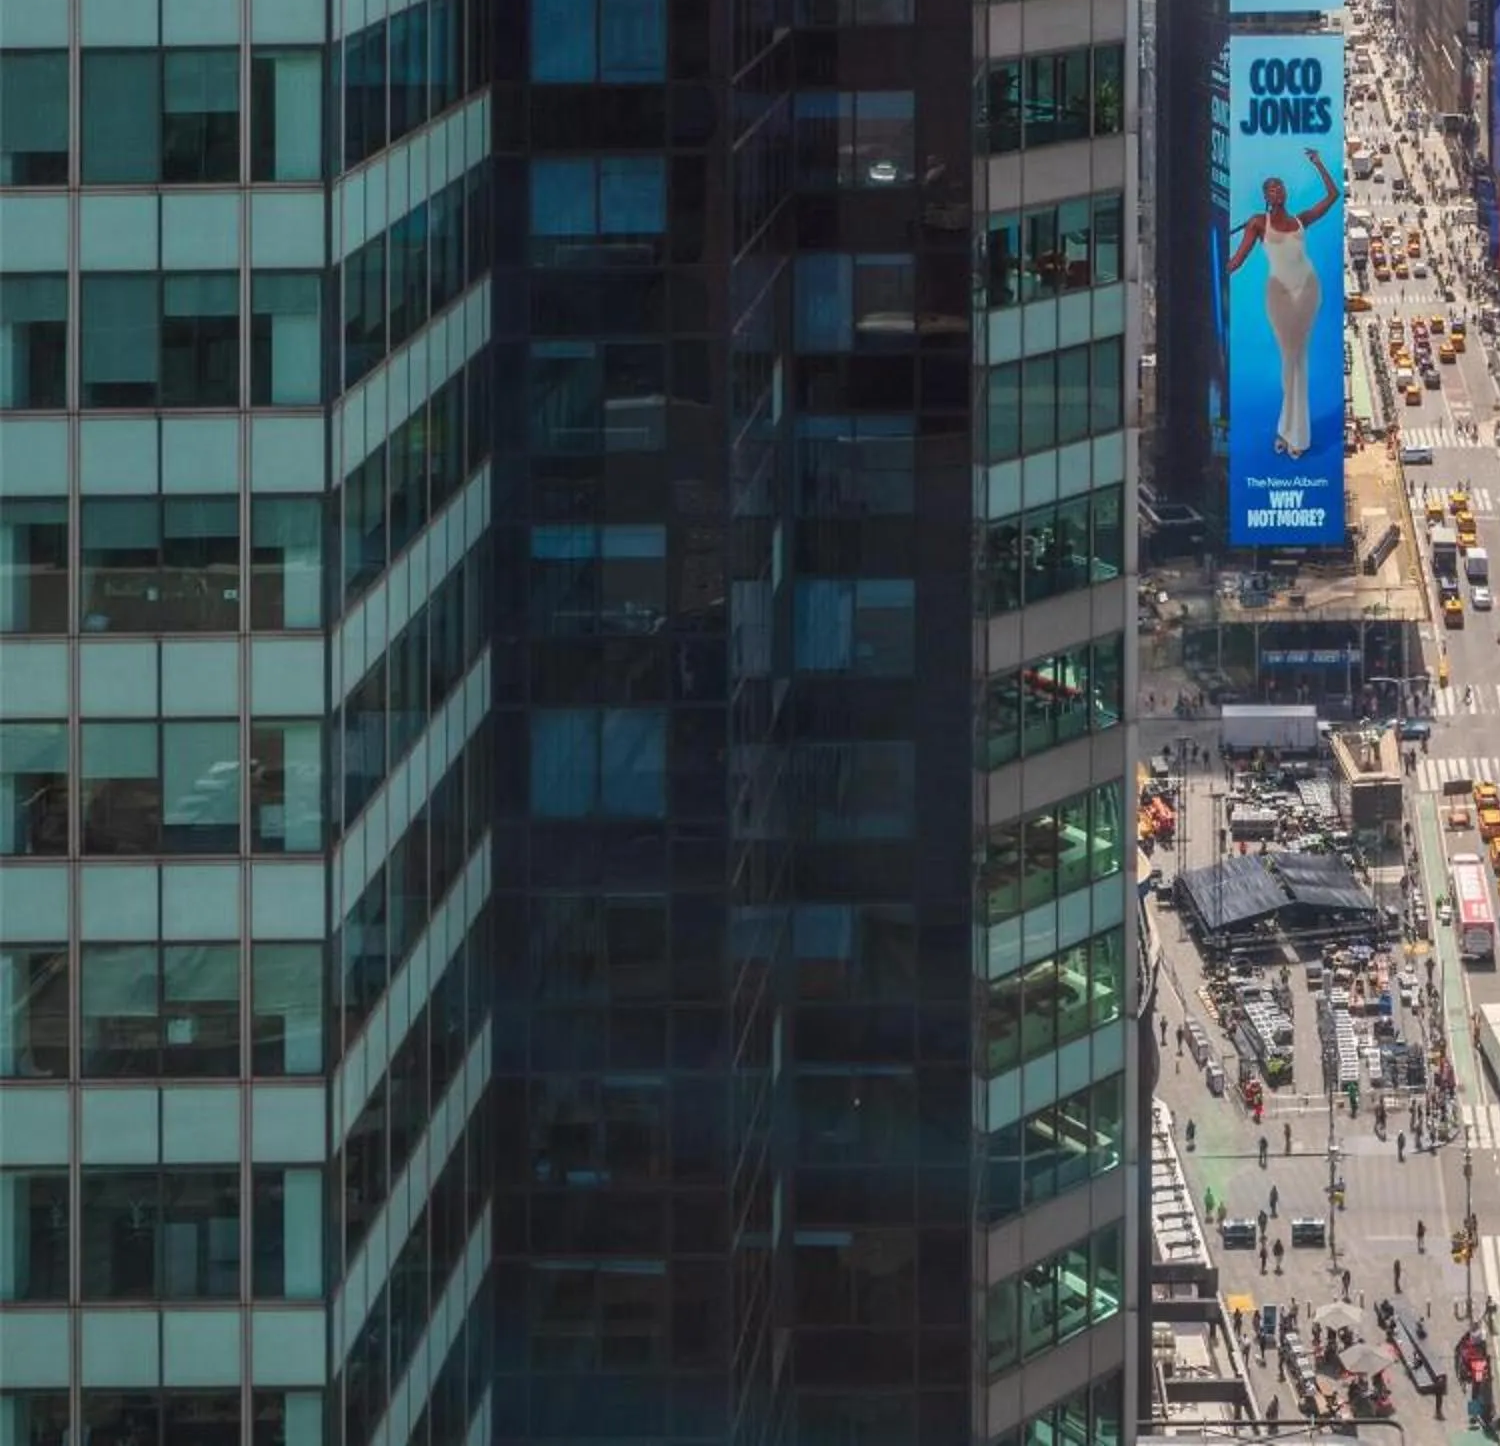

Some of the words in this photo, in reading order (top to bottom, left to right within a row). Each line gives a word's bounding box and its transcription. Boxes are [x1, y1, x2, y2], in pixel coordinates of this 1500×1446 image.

[1249, 58, 1321, 96] COCO
[1240, 96, 1331, 136] JONES
[1247, 477, 1266, 488] The
[1267, 477, 1292, 488] New
[1293, 476, 1328, 488] Album
[1269, 490, 1304, 508] WHY
[1247, 509, 1276, 528] NOT
[1277, 509, 1325, 527] MORE?
